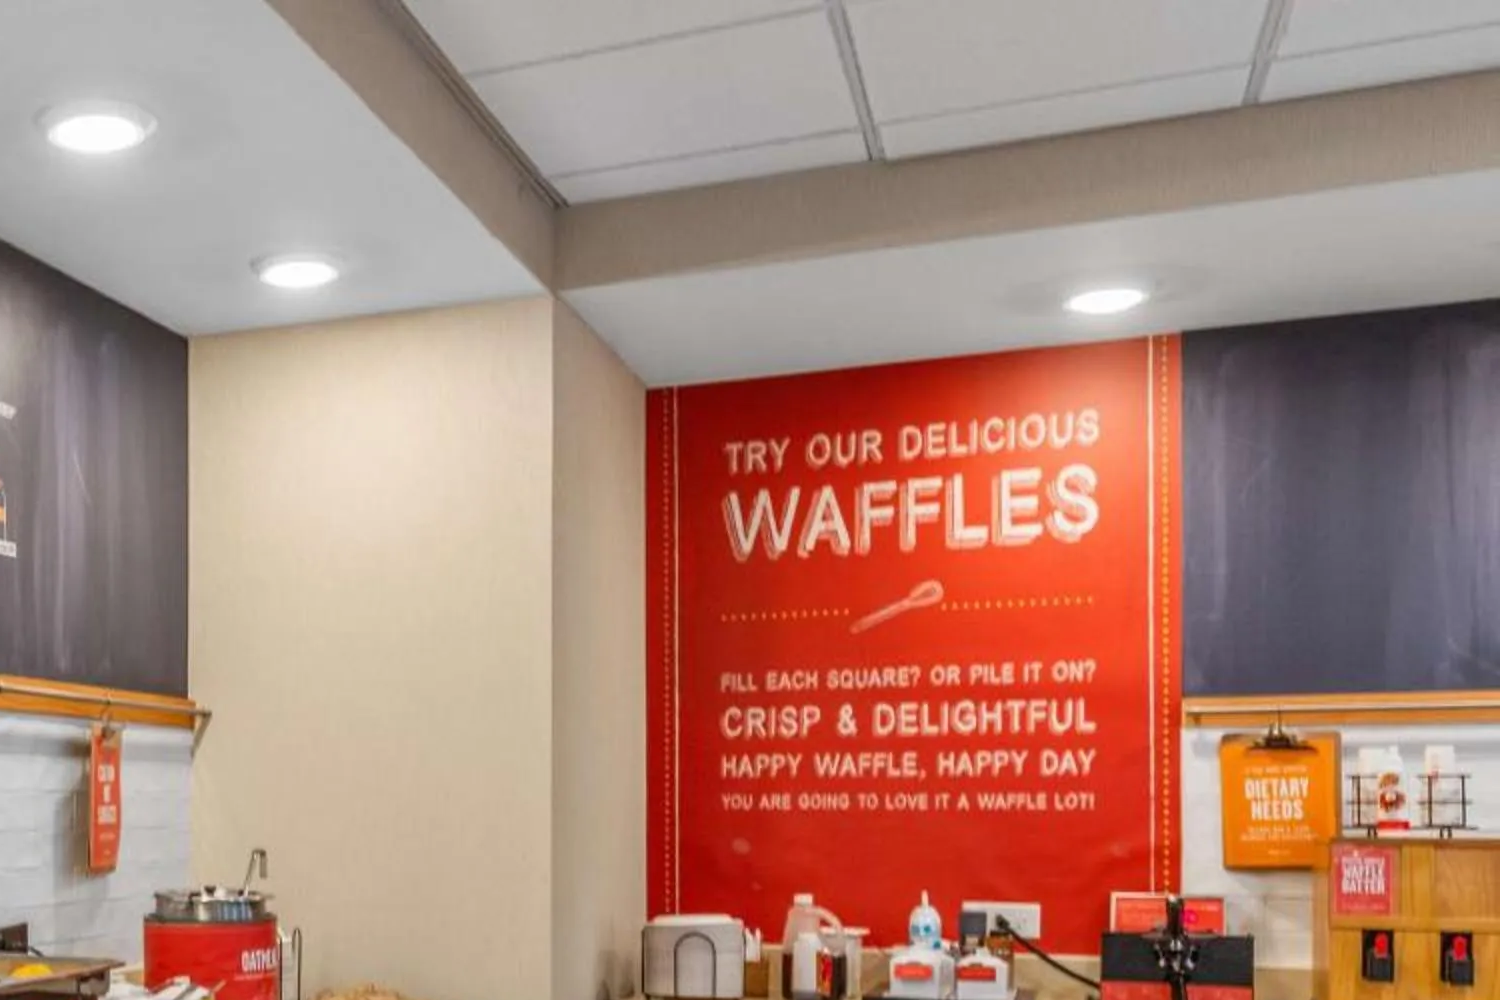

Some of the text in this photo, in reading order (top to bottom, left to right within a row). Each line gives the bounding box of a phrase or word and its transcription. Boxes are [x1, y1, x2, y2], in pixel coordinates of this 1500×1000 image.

[723, 408, 1100, 475] TRY OUR DELICIOUS
[722, 462, 1100, 563] WAFFLES
[720, 658, 1097, 693] FILL EACH SQUARE? OR PILE IT ON?
[720, 697, 1097, 740] CRISP & DELIGHTFUL
[721, 747, 1097, 781] HAPPY WAFFLE, HAPPY DAY
[721, 791, 1096, 812] YOU ARE GOING TO LOVE IT A WAFFLE LOT!
[1244, 776, 1309, 800] DIETARY
[1250, 799, 1304, 821] NEEDS
